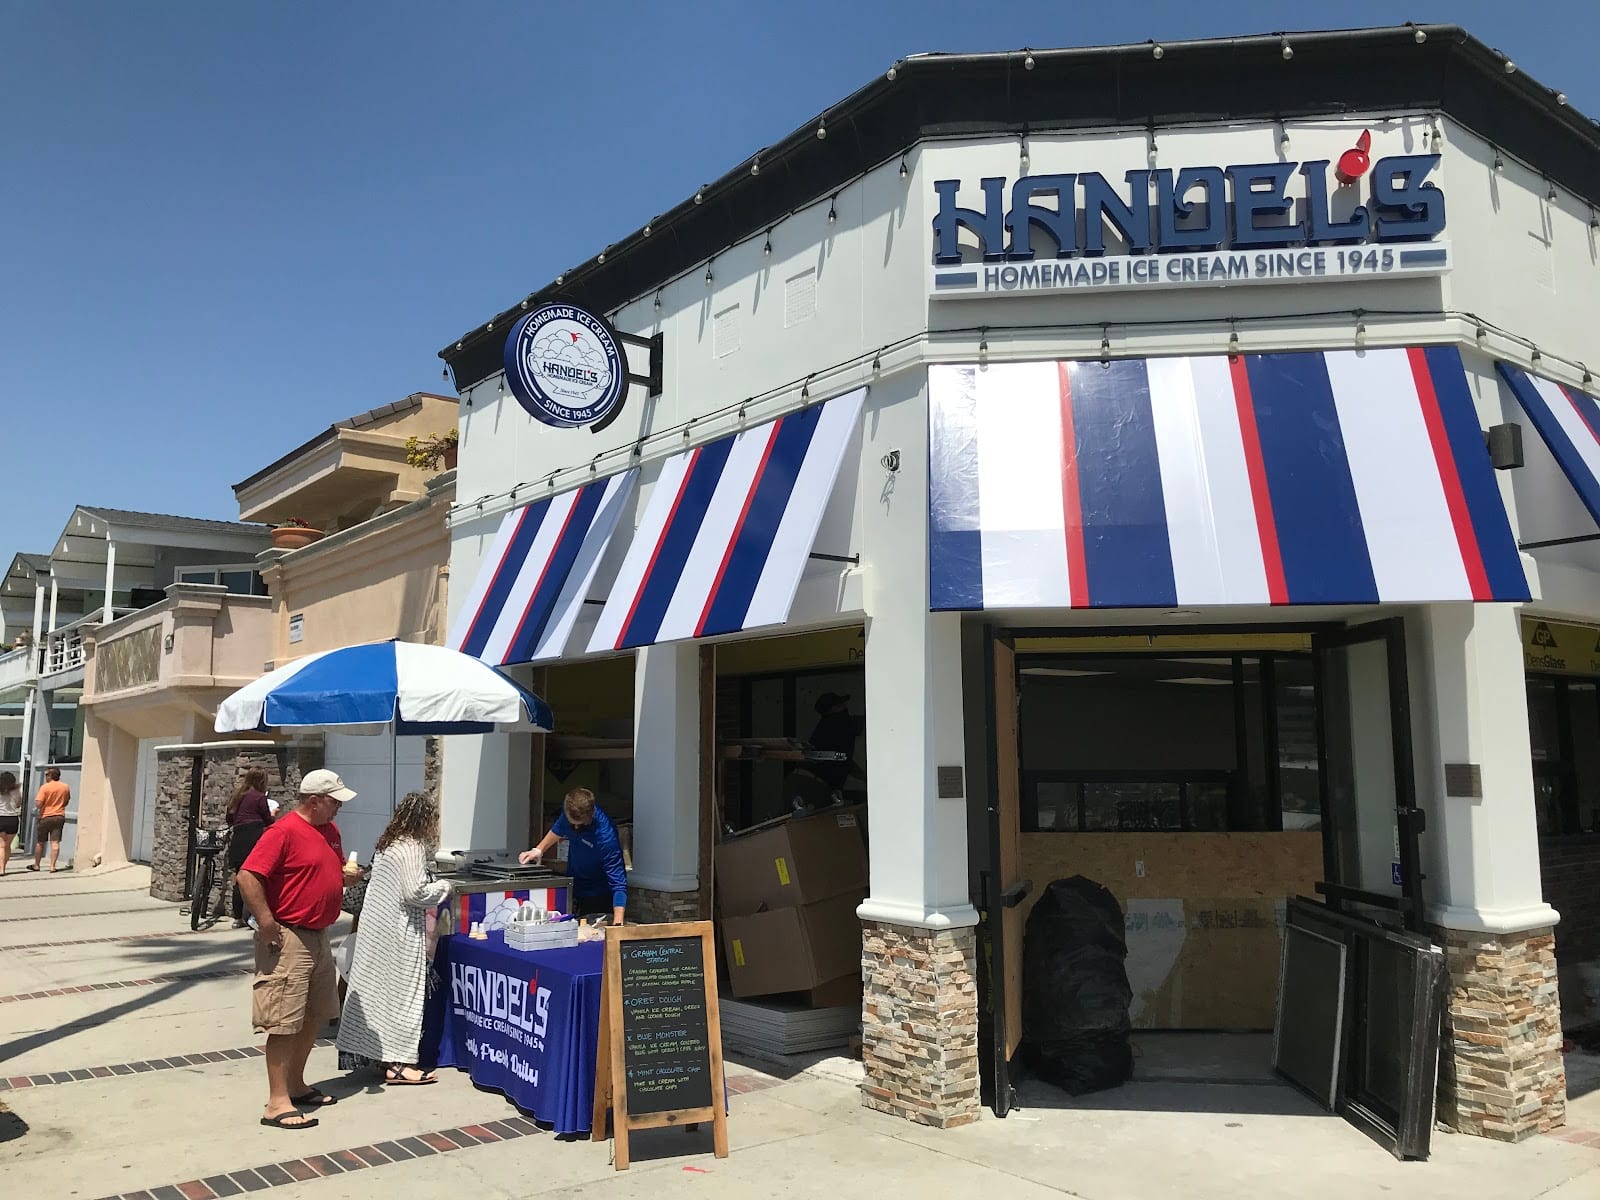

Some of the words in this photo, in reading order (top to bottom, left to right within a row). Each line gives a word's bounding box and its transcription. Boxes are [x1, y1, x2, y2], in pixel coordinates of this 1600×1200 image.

[932, 130, 1447, 264] HANDEL'S
[984, 262, 1120, 290] HOMEMADE
[1126, 258, 1160, 284] ICE
[1166, 255, 1249, 282] CREAM
[1254, 251, 1326, 277] SINCE
[1337, 249, 1394, 274] 1945
[525, 309, 574, 337] HOMEMADE
[576, 312, 591, 326] ICE
[590, 322, 615, 357] CREAM
[543, 362, 598, 383] HANDEL'S
[544, 399, 571, 418] SINCE
[573, 408, 592, 419] 1945
[1526, 652, 1567, 670] DensGlass
[630, 949, 658, 959] GRAHAM
[660, 946, 684, 956] CENTRAL
[451, 962, 552, 1039] HANDEL'S
[658, 995, 682, 1004] DOUGH
[523, 1033, 539, 1050] 1945
[636, 1032, 653, 1041] BLUE
[655, 1029, 688, 1040] MONSTER
[510, 1054, 539, 1088] Daily
[637, 1068, 655, 1077] MINT
[655, 1066, 684, 1075] CHOCOLATE
